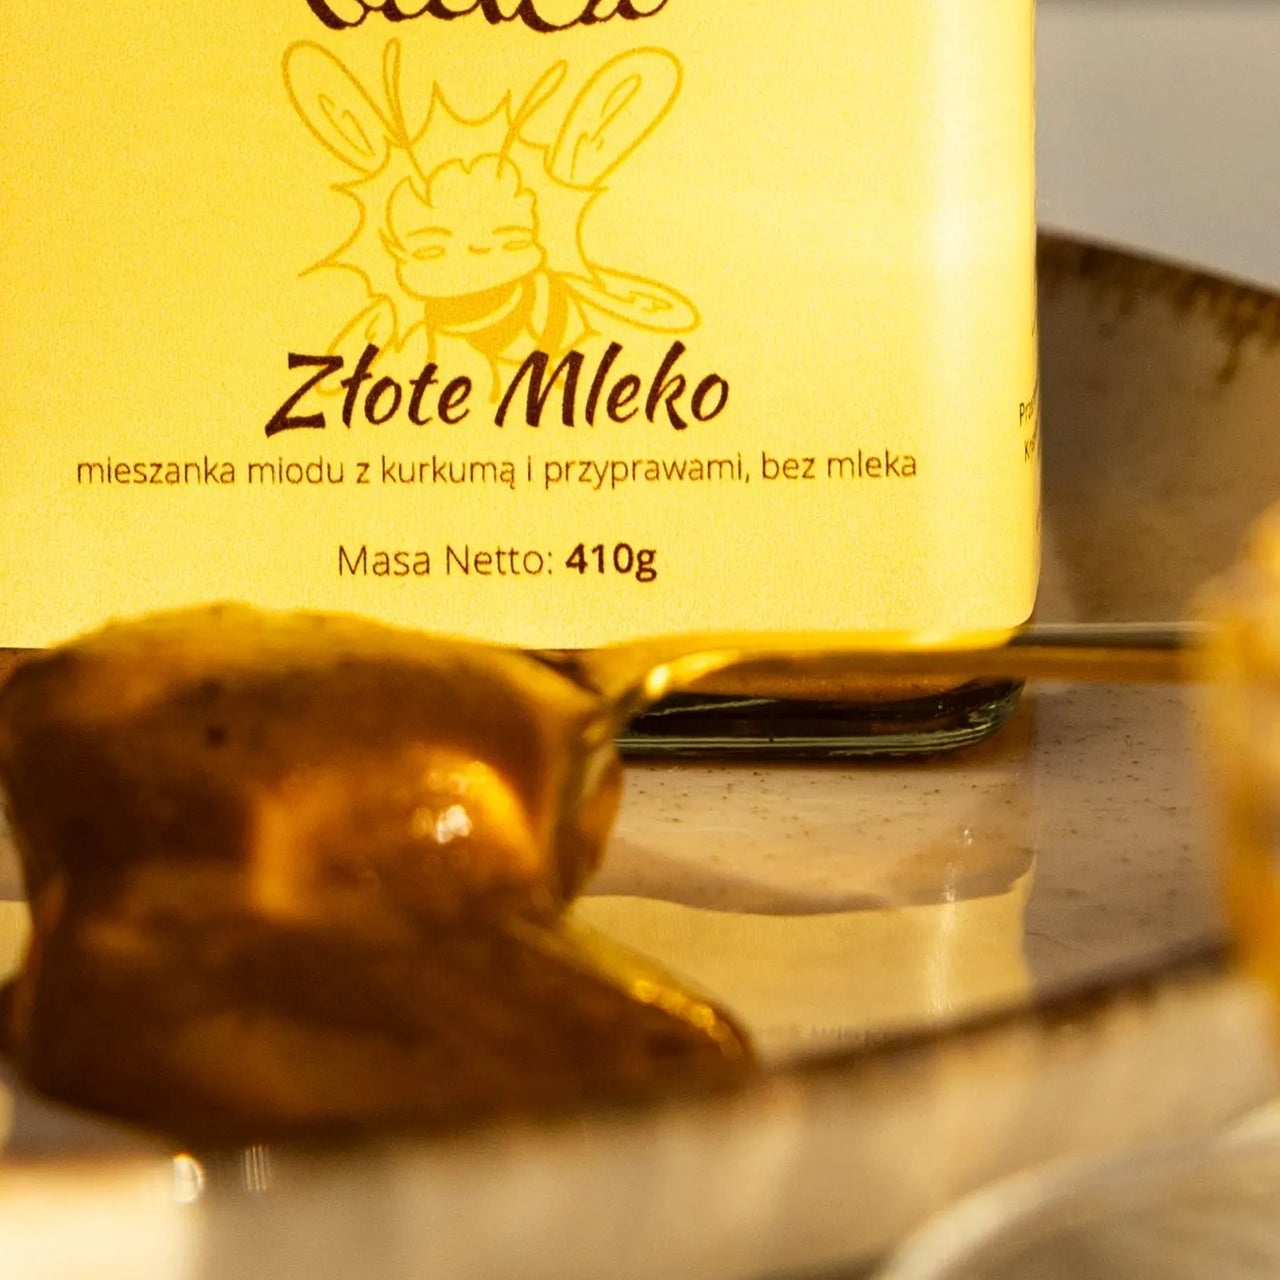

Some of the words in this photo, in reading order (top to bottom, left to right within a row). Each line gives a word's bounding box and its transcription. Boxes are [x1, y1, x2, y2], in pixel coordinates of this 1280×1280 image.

[264, 343, 473, 438] Złote
[494, 340, 729, 431] Mleko
[77, 454, 235, 485] mieszanka
[248, 455, 344, 485] miodu
[356, 462, 370, 484] z
[381, 454, 515, 490] kurkumą
[526, 454, 533, 482] i
[544, 451, 751, 491] przyprawami,
[761, 451, 816, 481] bez
[827, 448, 918, 479] mleka
[338, 544, 431, 577] Masa
[446, 543, 553, 576] Netto:
[564, 542, 658, 583] 410g
